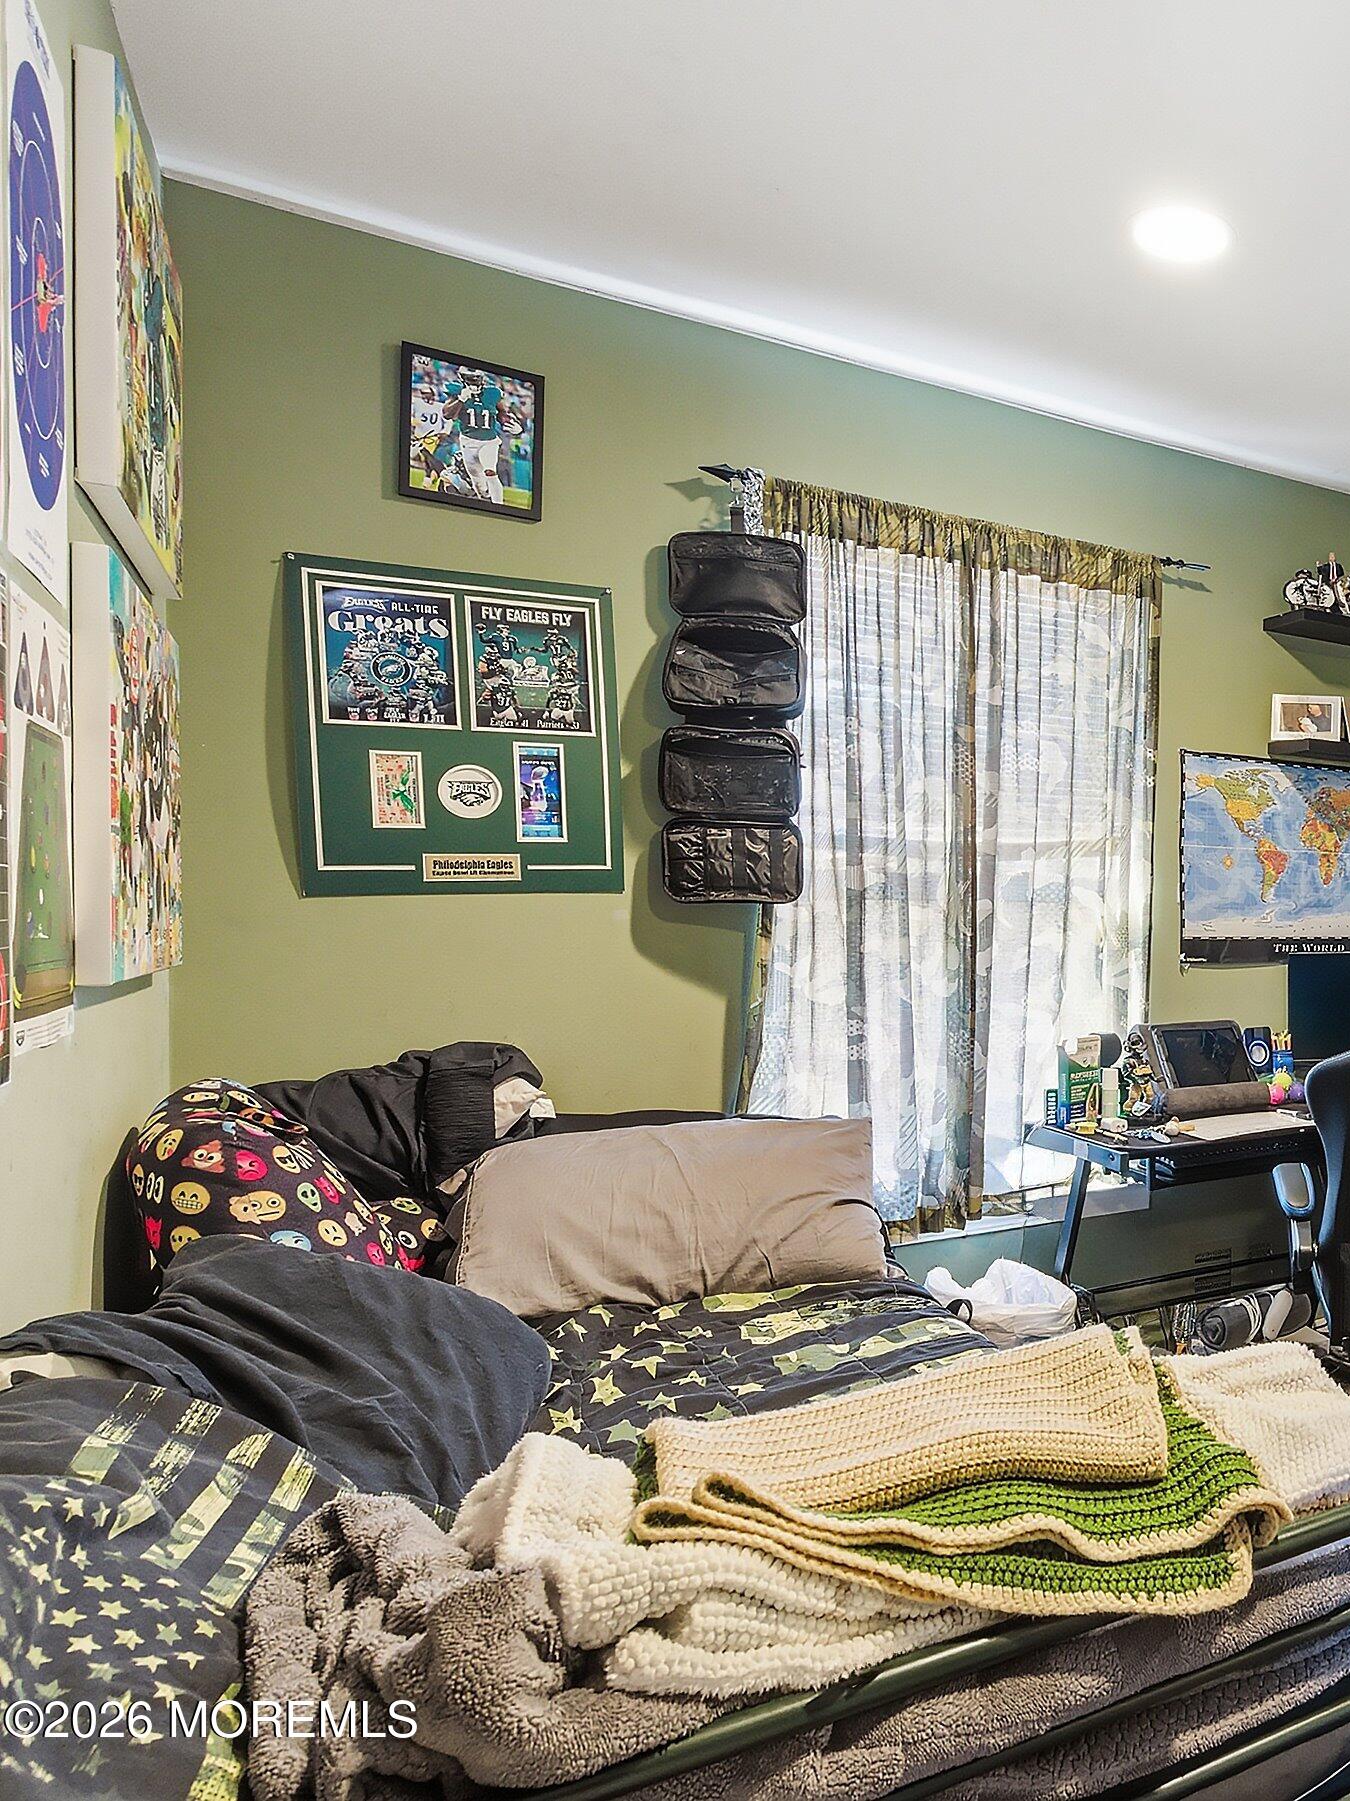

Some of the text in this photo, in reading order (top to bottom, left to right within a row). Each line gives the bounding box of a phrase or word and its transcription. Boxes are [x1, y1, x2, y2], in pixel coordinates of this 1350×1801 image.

[466, 408, 491, 430] 11
[328, 610, 450, 639] Greats
[481, 606, 572, 627] FLY EAGLES FLY
[451, 780, 491, 796] EAGLES
[432, 859, 514, 872] Philadelphia Eagles
